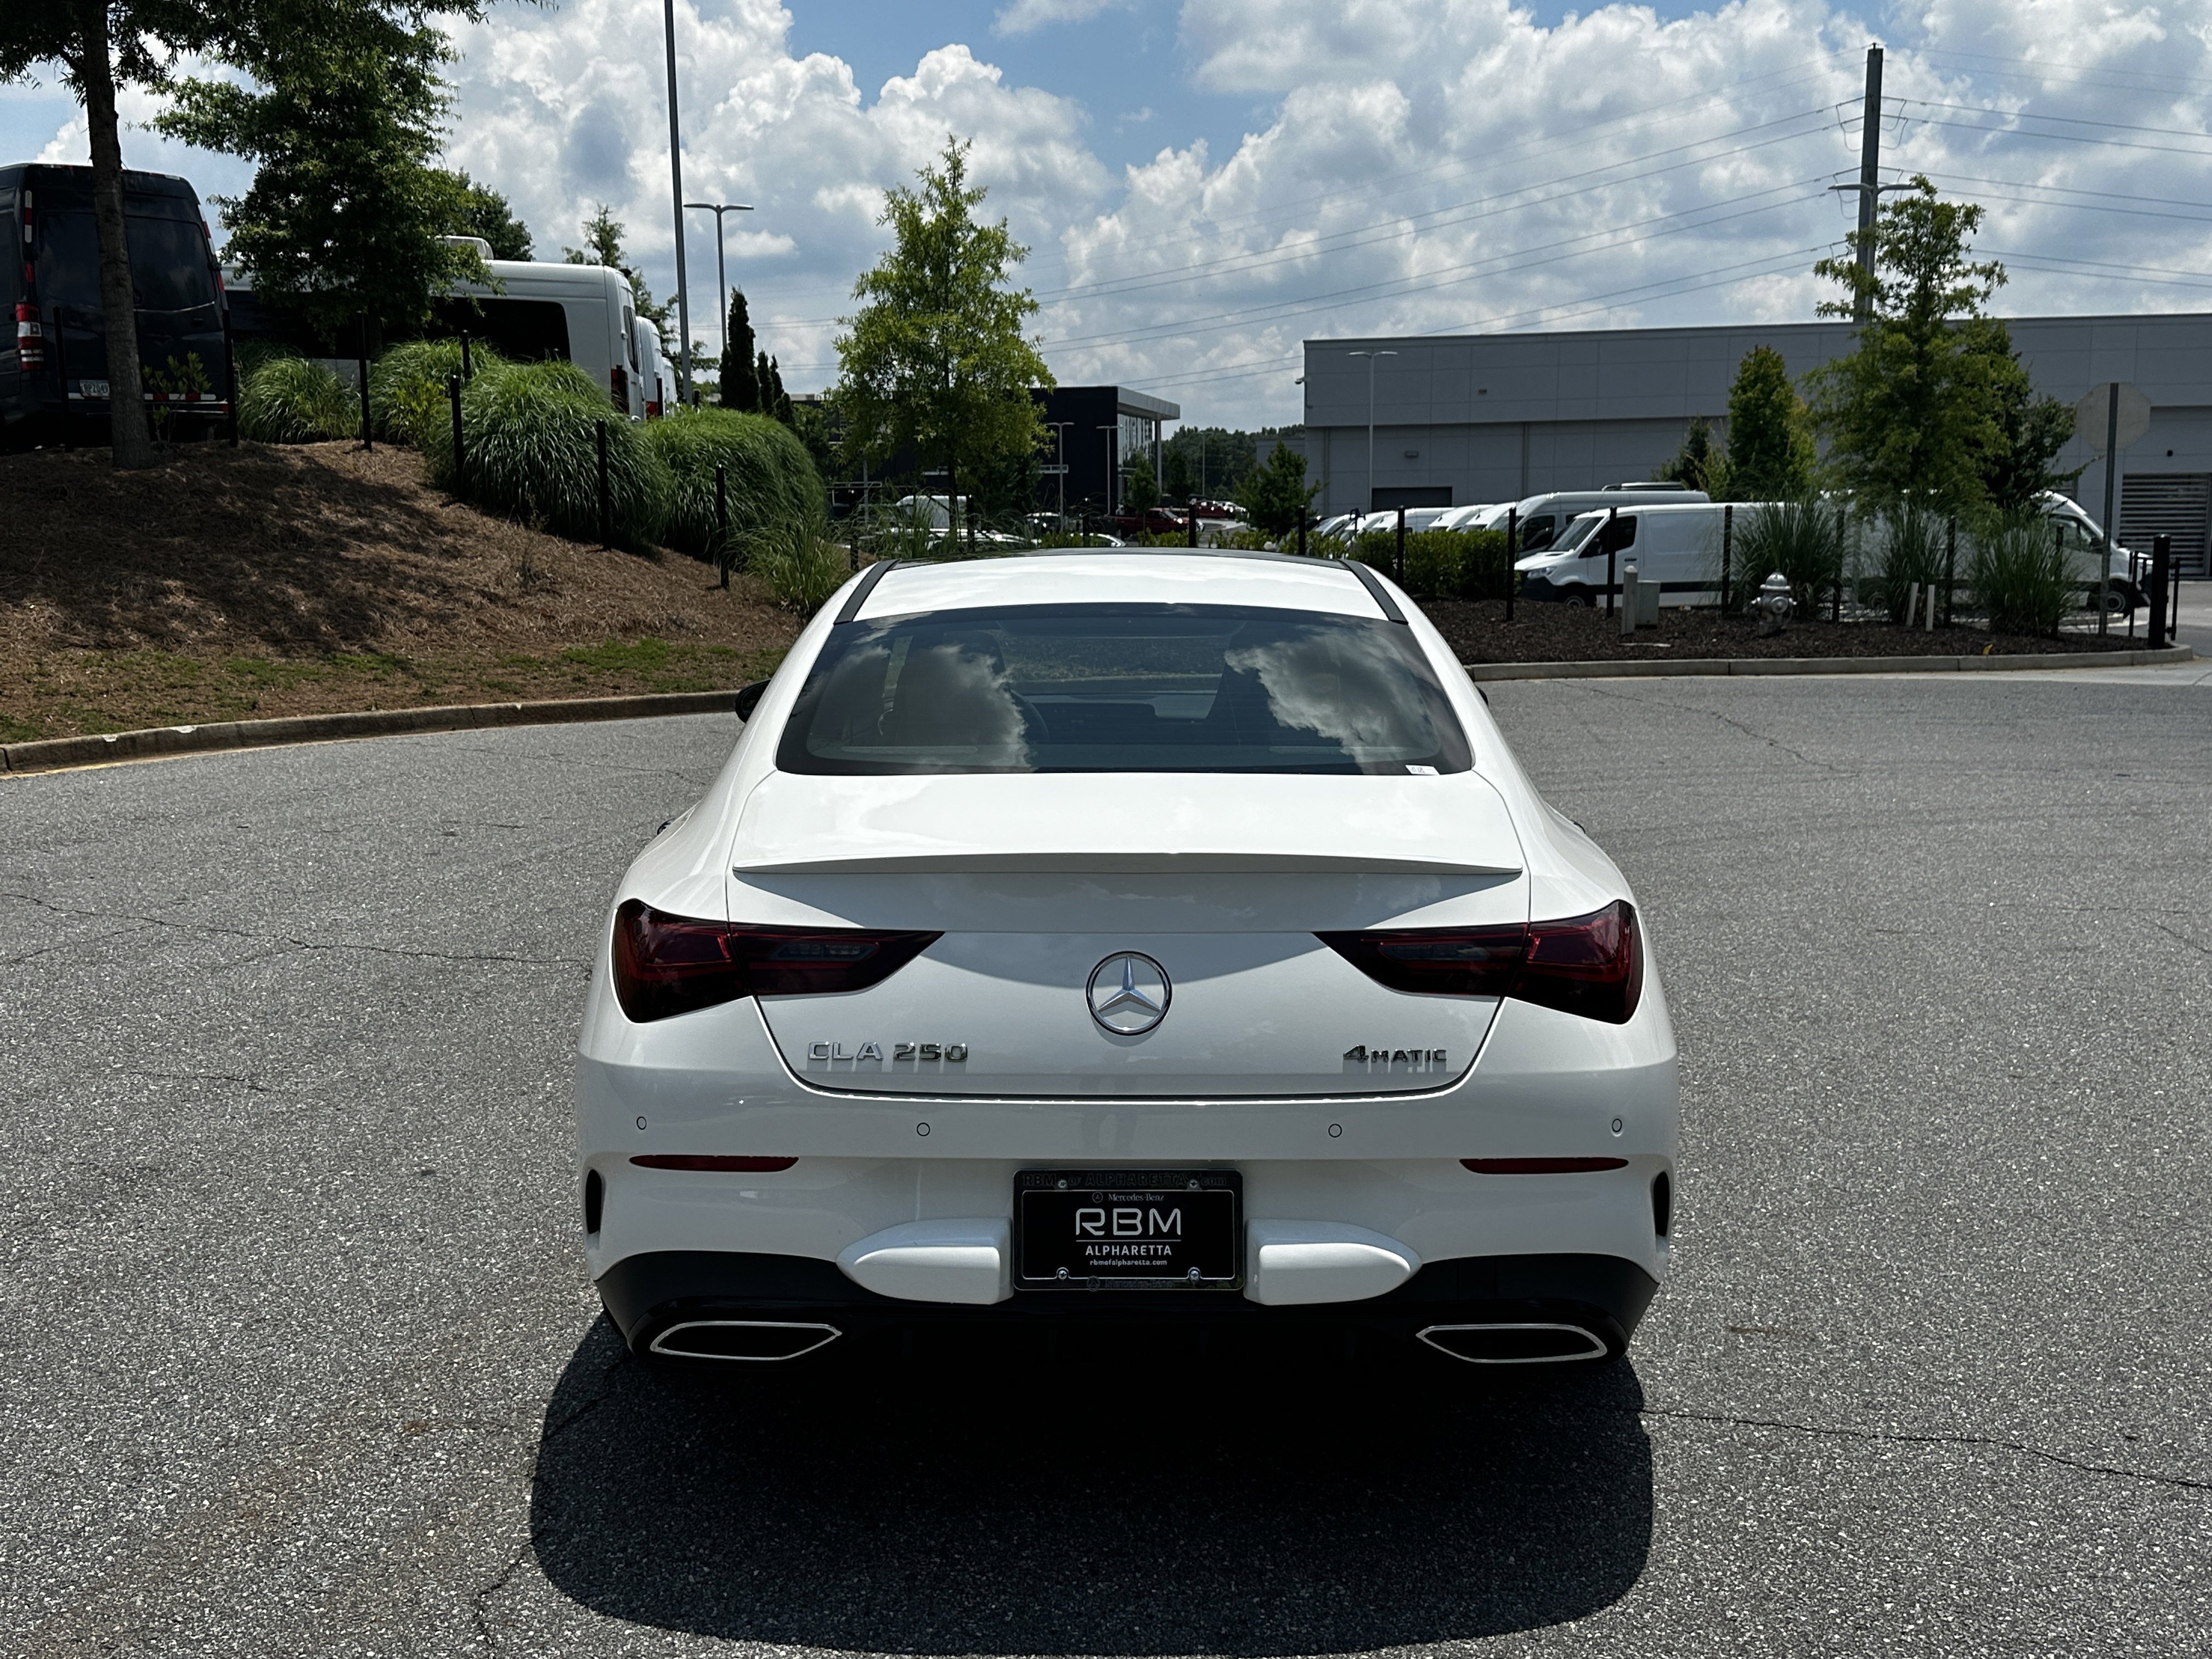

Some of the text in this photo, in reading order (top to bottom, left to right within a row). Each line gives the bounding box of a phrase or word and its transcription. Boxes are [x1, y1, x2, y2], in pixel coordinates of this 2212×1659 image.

[808, 1041, 968, 1062] CLA 250
[1343, 1044, 1447, 1063] 4MATIC
[1023, 1173, 1057, 1186] RBM
[1085, 1173, 1187, 1186] ALPHARETTA
[1108, 1193, 1165, 1201] Mercedes-Benz
[1075, 1207, 1182, 1235] RBM
[1085, 1245, 1172, 1256] ALPHARETTA
[1090, 1259, 1168, 1267] rbmofalpharetta.com
